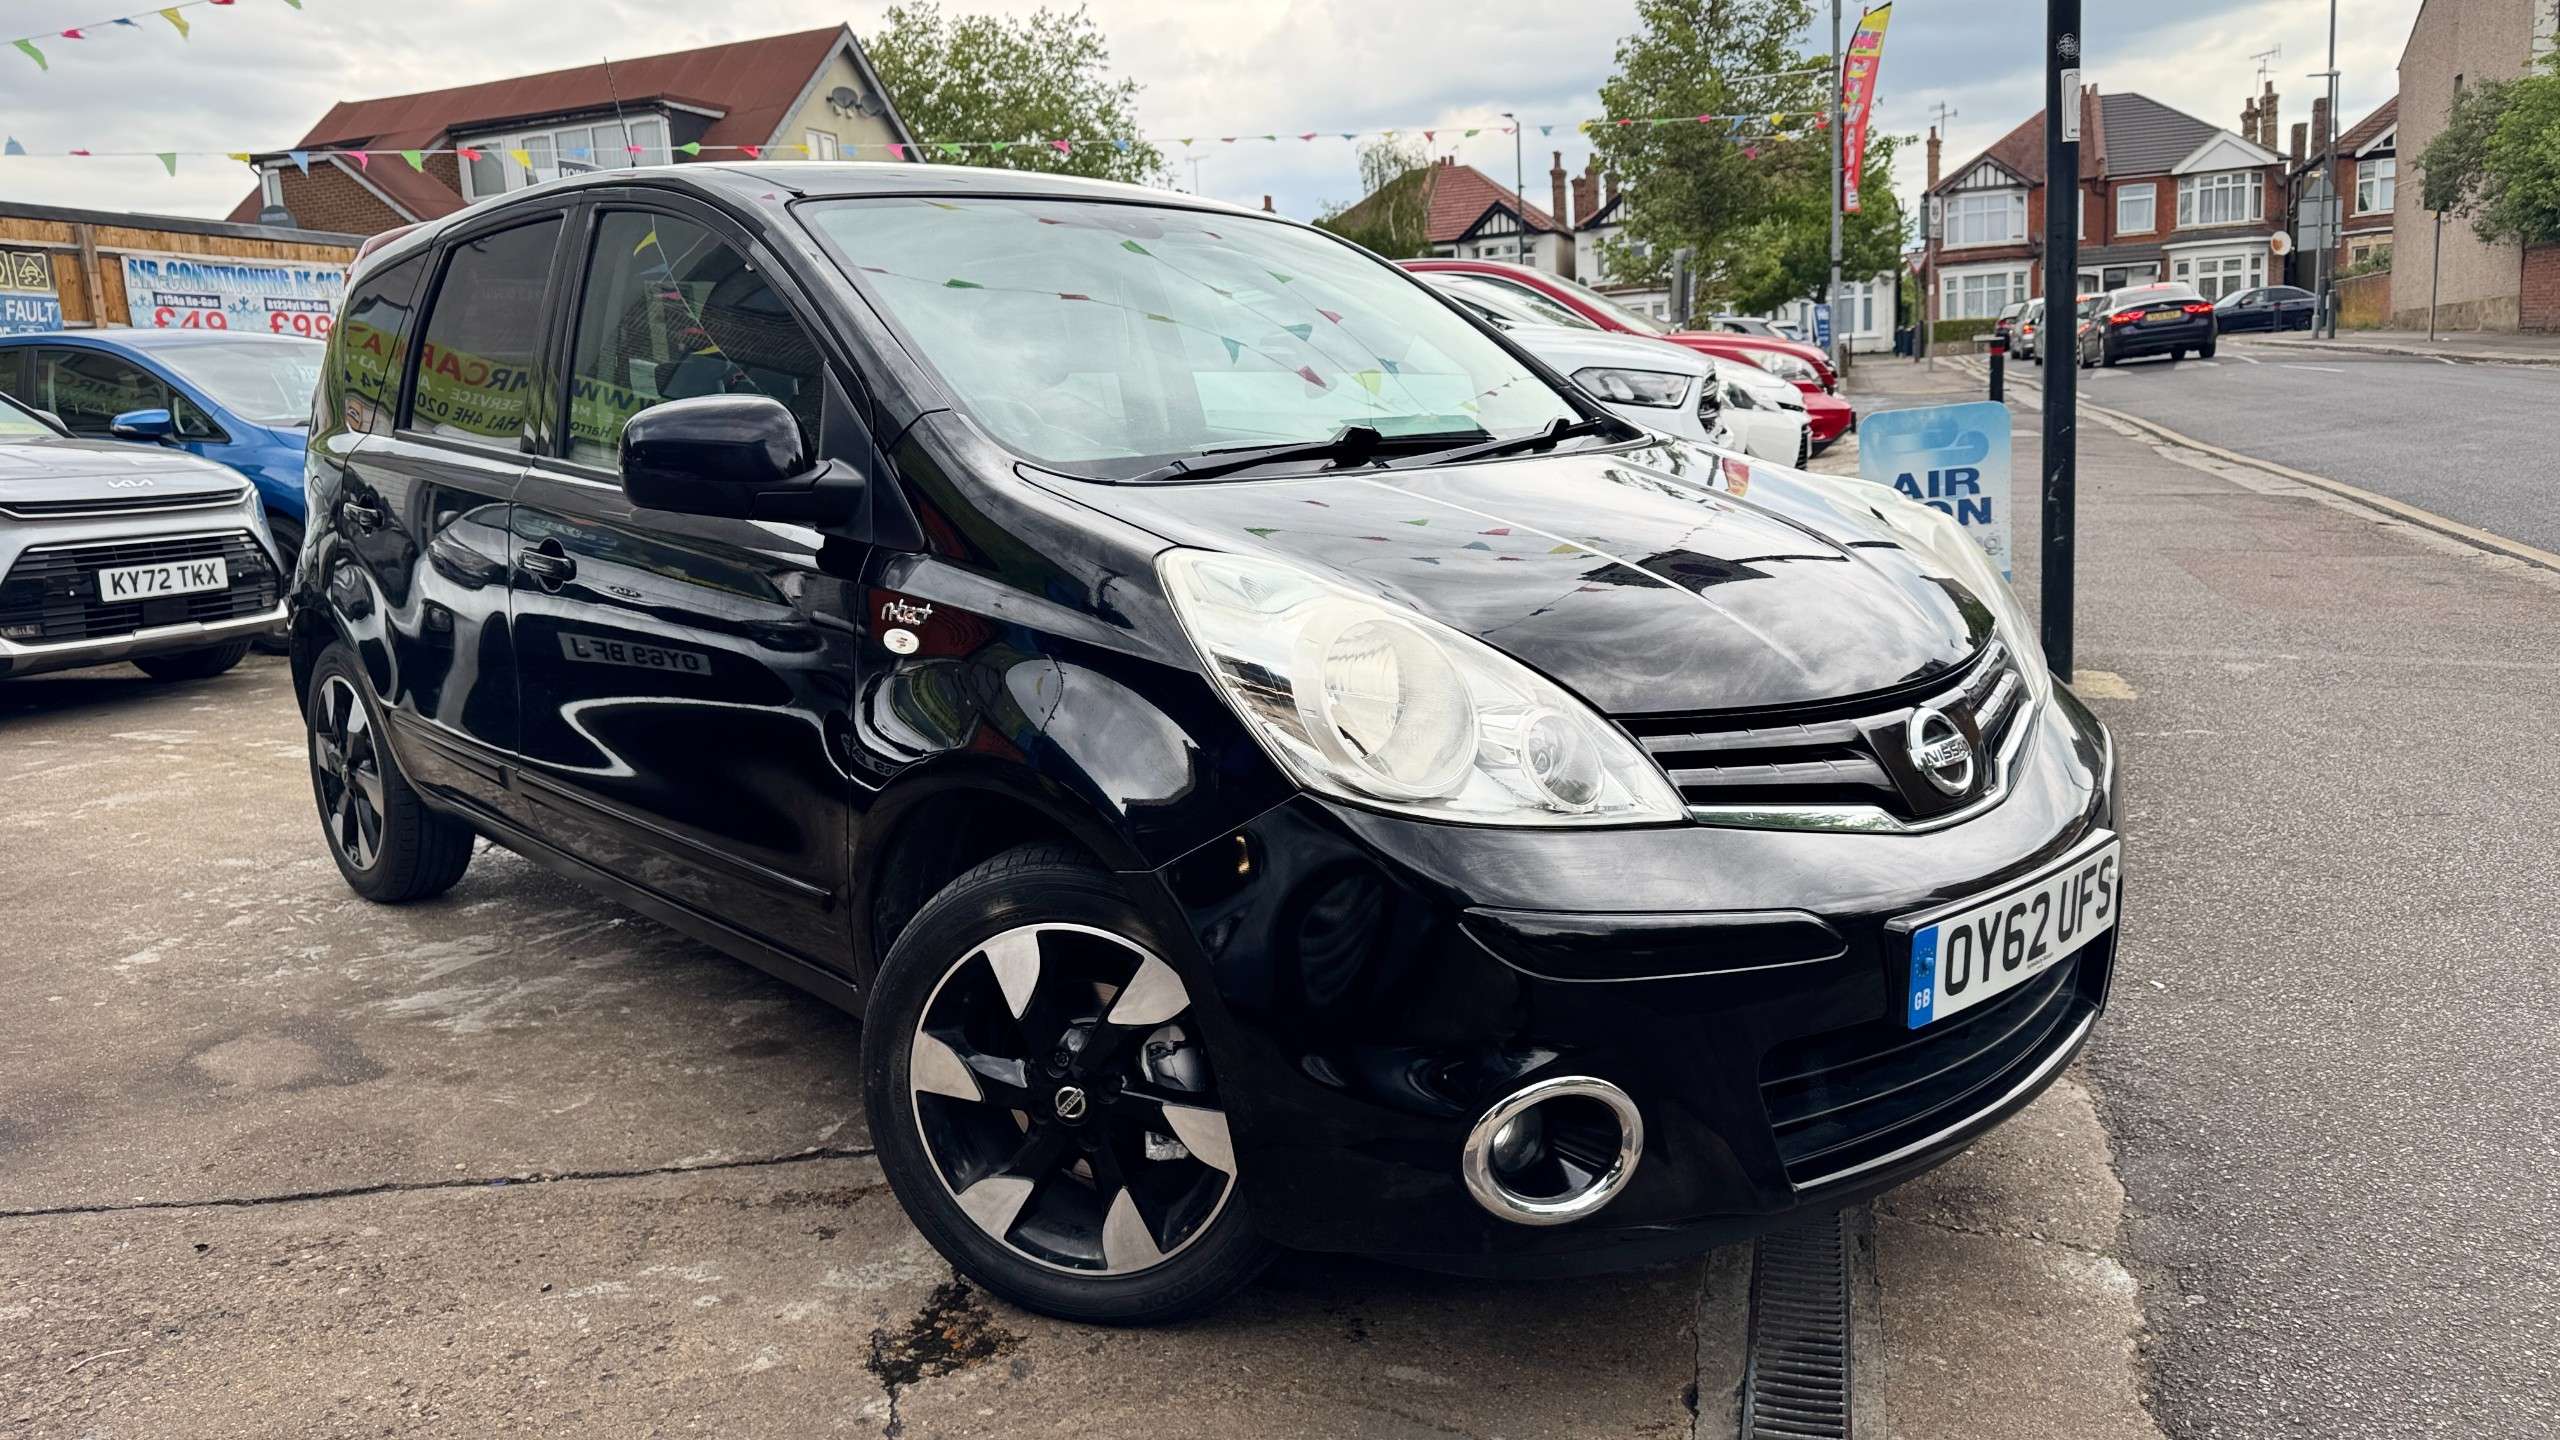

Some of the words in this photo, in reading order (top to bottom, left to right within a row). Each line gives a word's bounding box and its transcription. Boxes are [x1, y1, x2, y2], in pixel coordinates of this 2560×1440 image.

[5, 299, 55, 323] FAULT
[1893, 467, 1981, 500] AIR
[110, 568, 173, 596] KY72
[176, 562, 219, 588] TKX
[1944, 890, 2050, 997] OY62
[2057, 855, 2114, 943] UFS
[1914, 988, 1931, 1011] GB
